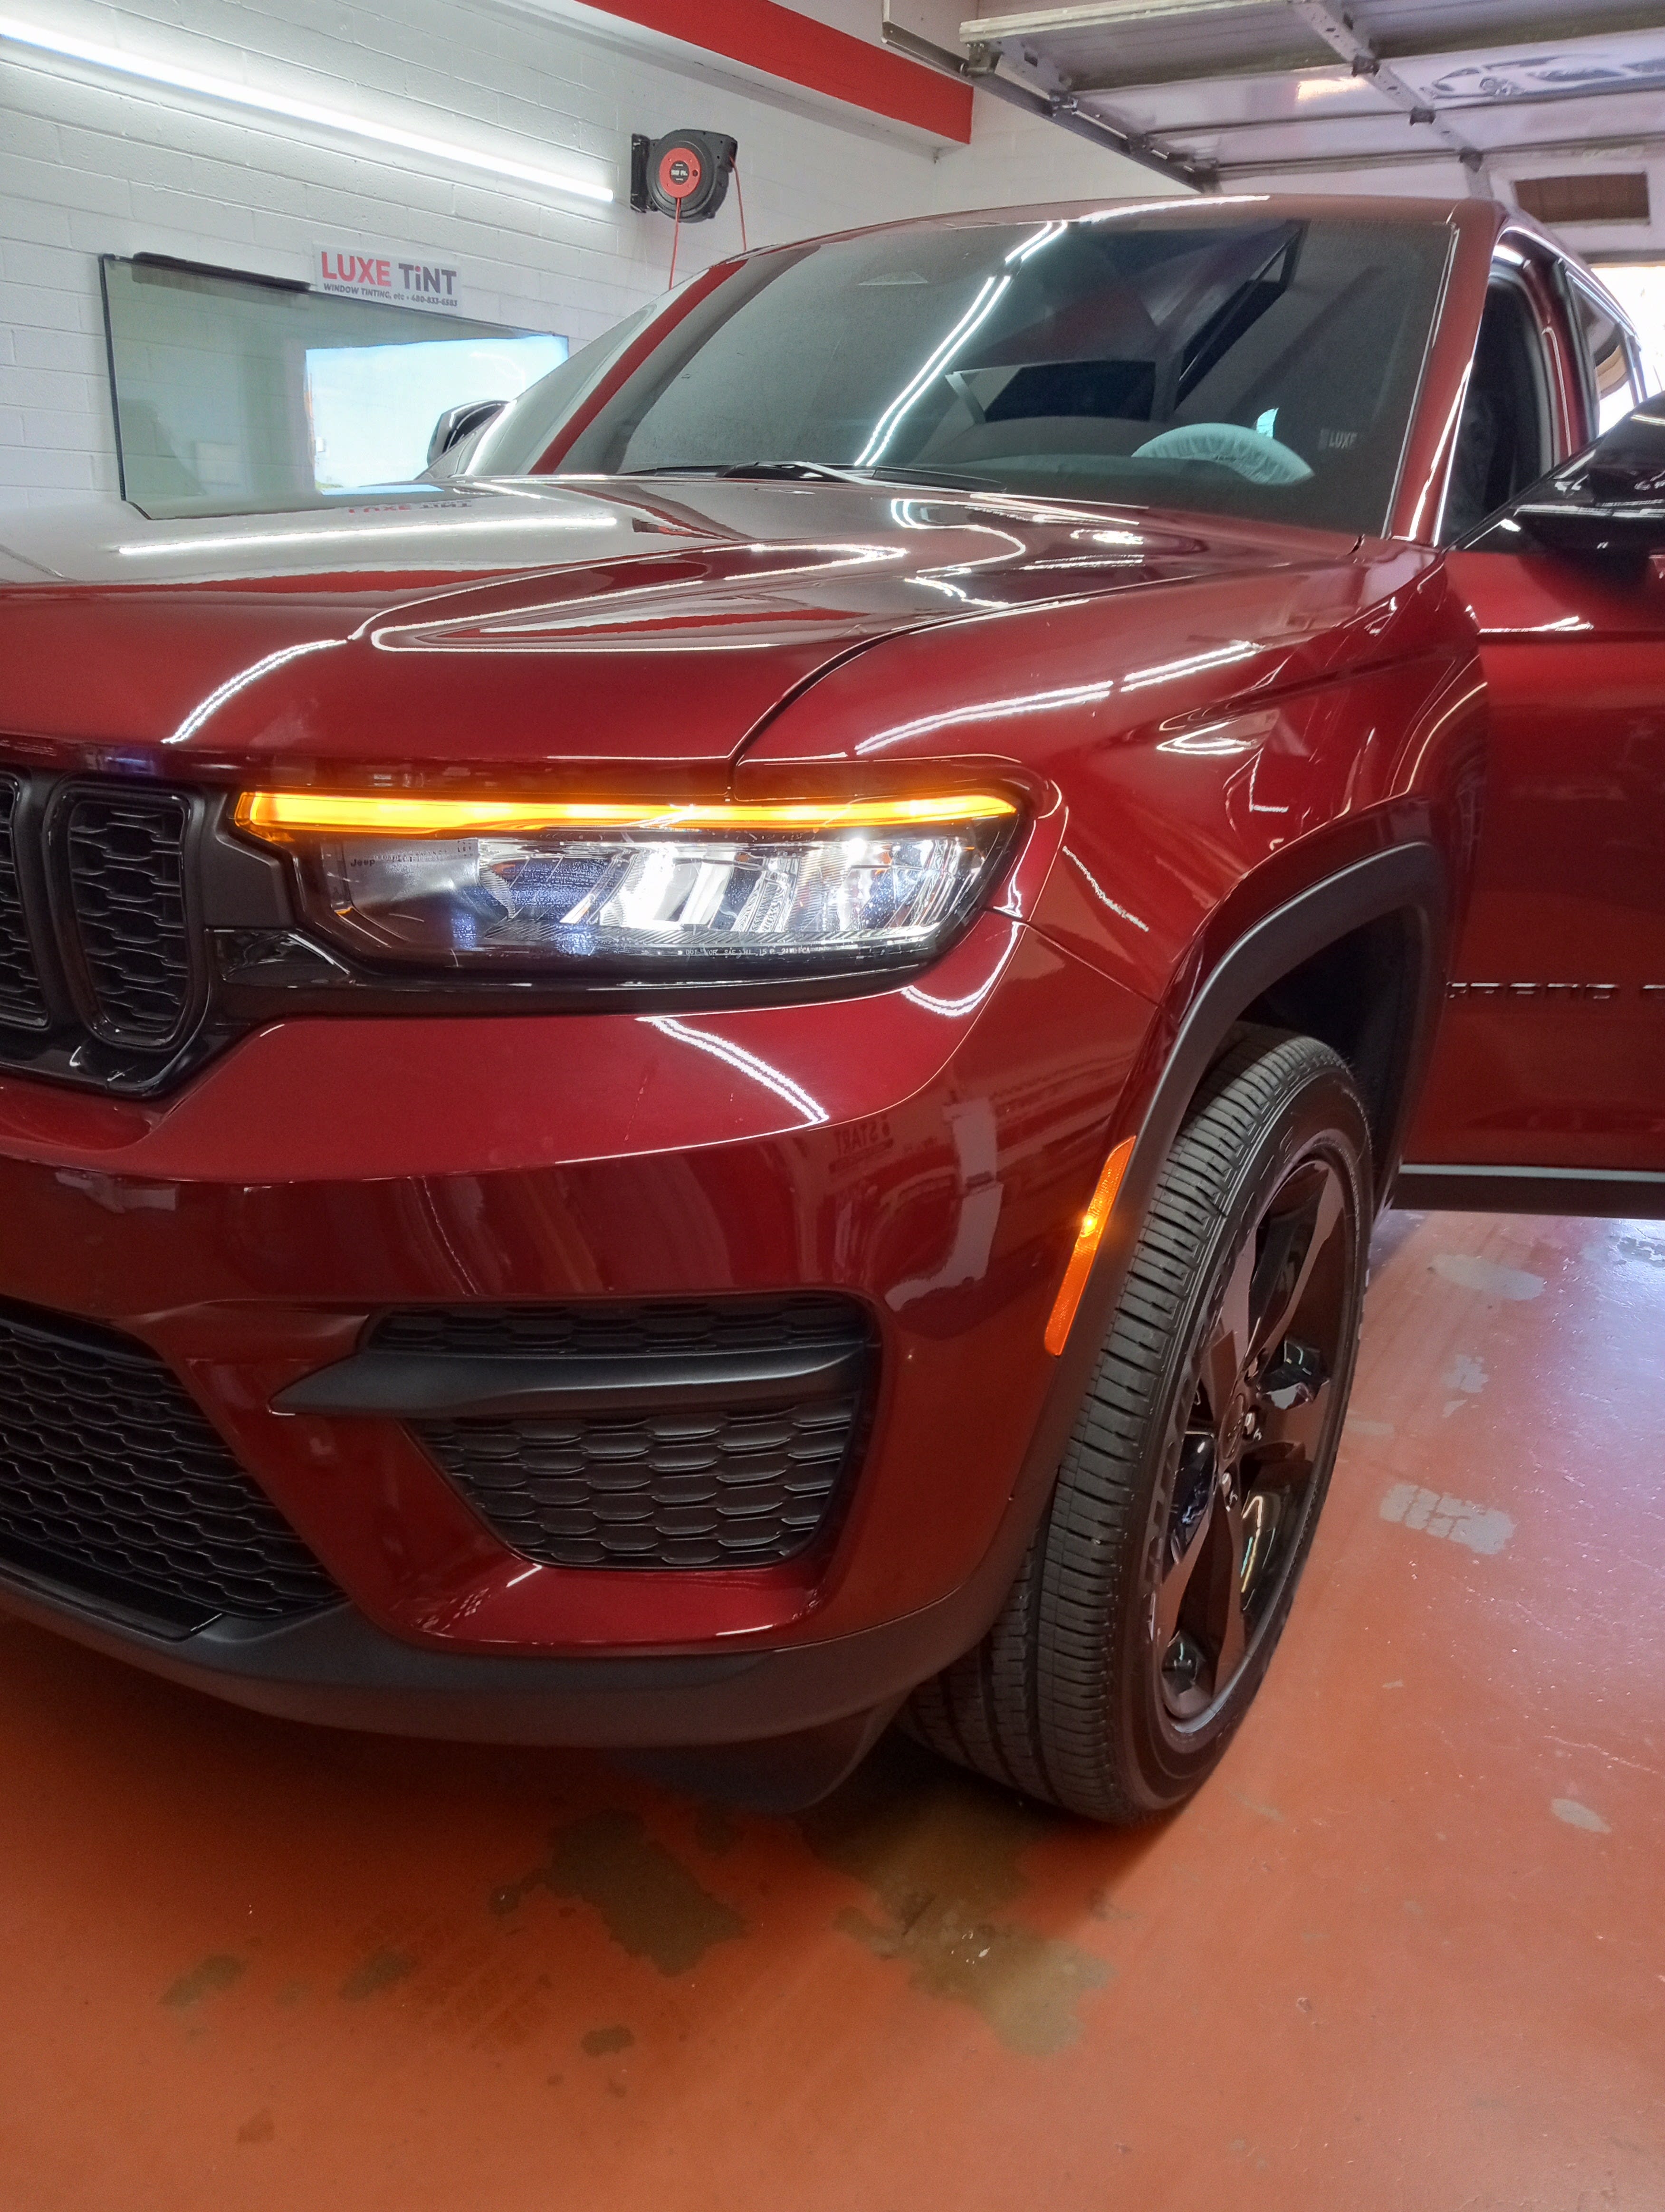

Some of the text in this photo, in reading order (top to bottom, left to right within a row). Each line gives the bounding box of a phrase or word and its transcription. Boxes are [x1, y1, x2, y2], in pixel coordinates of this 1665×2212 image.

[321, 251, 392, 287] LUXE
[324, 283, 359, 295] WINDOW
[351, 858, 375, 867] Jeep
